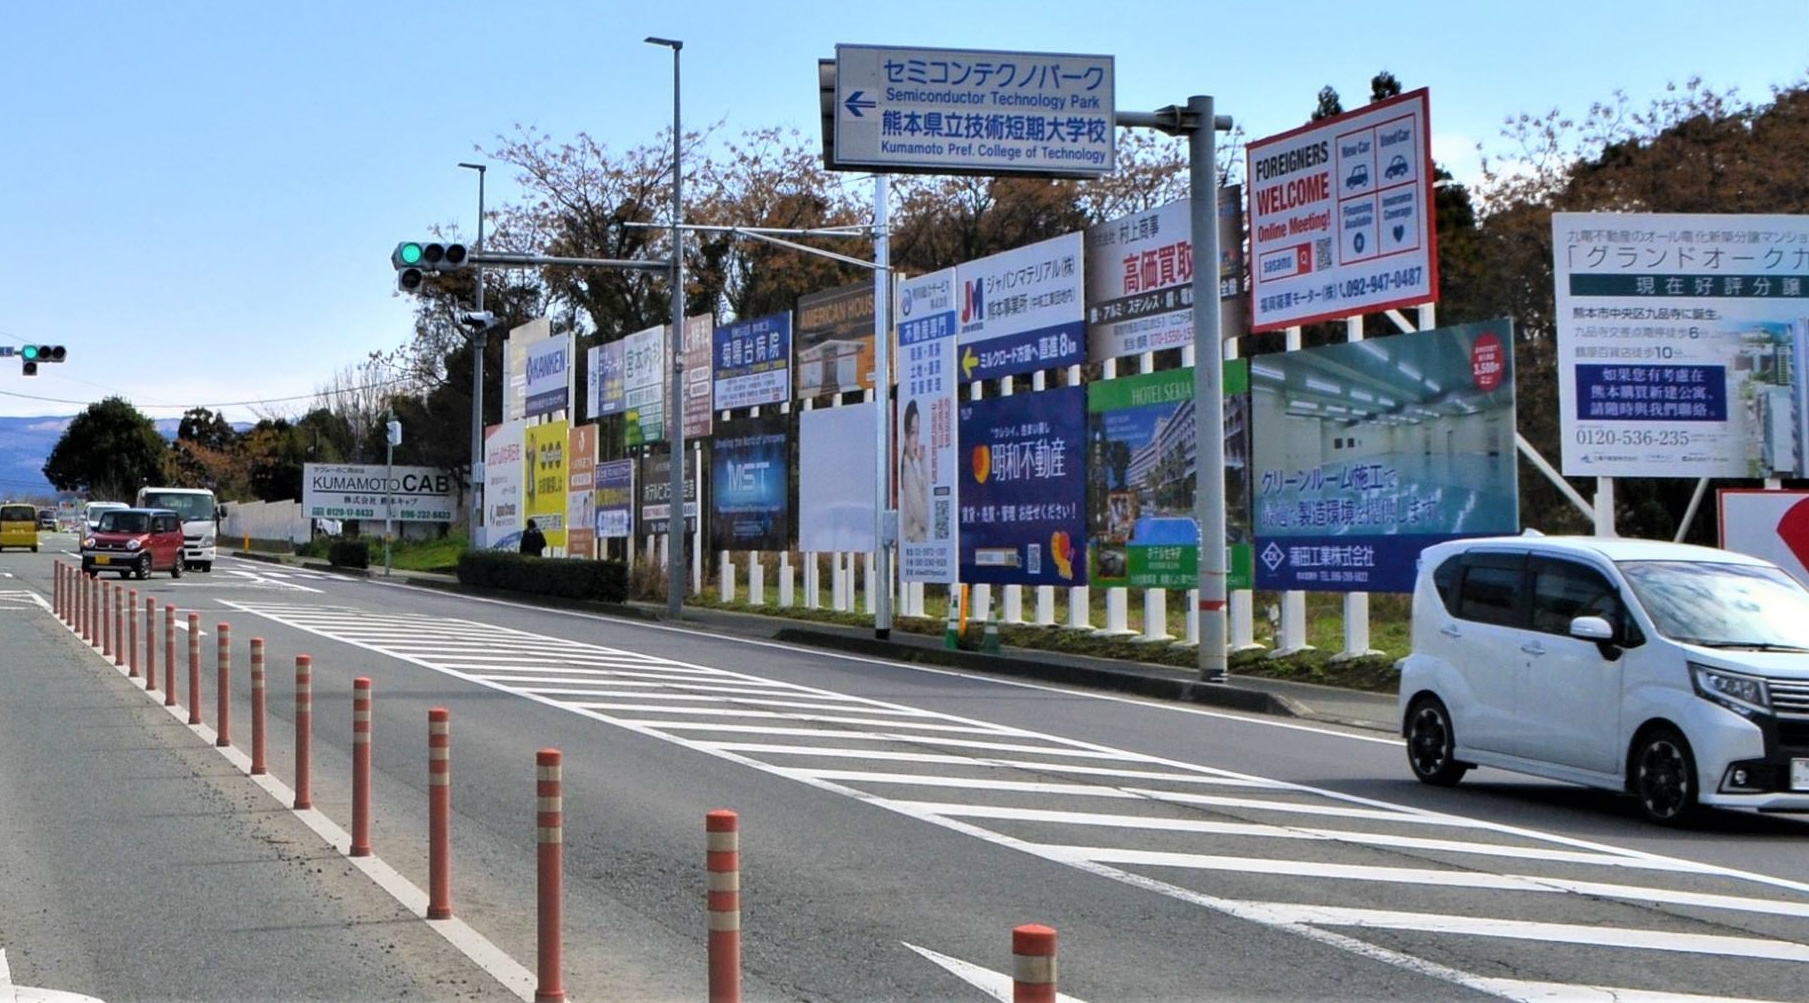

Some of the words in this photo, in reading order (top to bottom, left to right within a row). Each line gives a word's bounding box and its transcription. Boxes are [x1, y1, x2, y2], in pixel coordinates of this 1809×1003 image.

[884, 58, 1104, 89] セミコンテクノパーク
[886, 87, 985, 105] Semiconductor
[991, 91, 1066, 110] Technology
[1070, 95, 1100, 109] Park
[881, 109, 1107, 144] 熊本県立技術短期大学校
[1398, 128, 1411, 141] Car
[881, 141, 943, 155] Kumamoto
[948, 143, 975, 156] Pref.
[978, 144, 1021, 160] College
[1025, 147, 1036, 159] of
[1043, 147, 1106, 164] Technology
[1256, 141, 1329, 182] FOREIGNERS
[1358, 140, 1371, 154] Car
[1256, 172, 1330, 216] WELCOME
[1119, 215, 1160, 244] 村上商事
[1258, 221, 1287, 243] Online
[1289, 209, 1331, 235] Meeting!
[1123, 241, 1193, 294] 高価買取
[1346, 266, 1423, 298] 092-947-0487
[1131, 386, 1162, 406] HOTEL
[1576, 429, 1690, 446] 0120-536-235
[991, 437, 1067, 482] 明和不動産
[313, 477, 400, 491] KUMAMOTO
[402, 474, 450, 493] CAB
[727, 460, 770, 494] MST
[1261, 464, 1396, 495] クリーンルーム施工で
